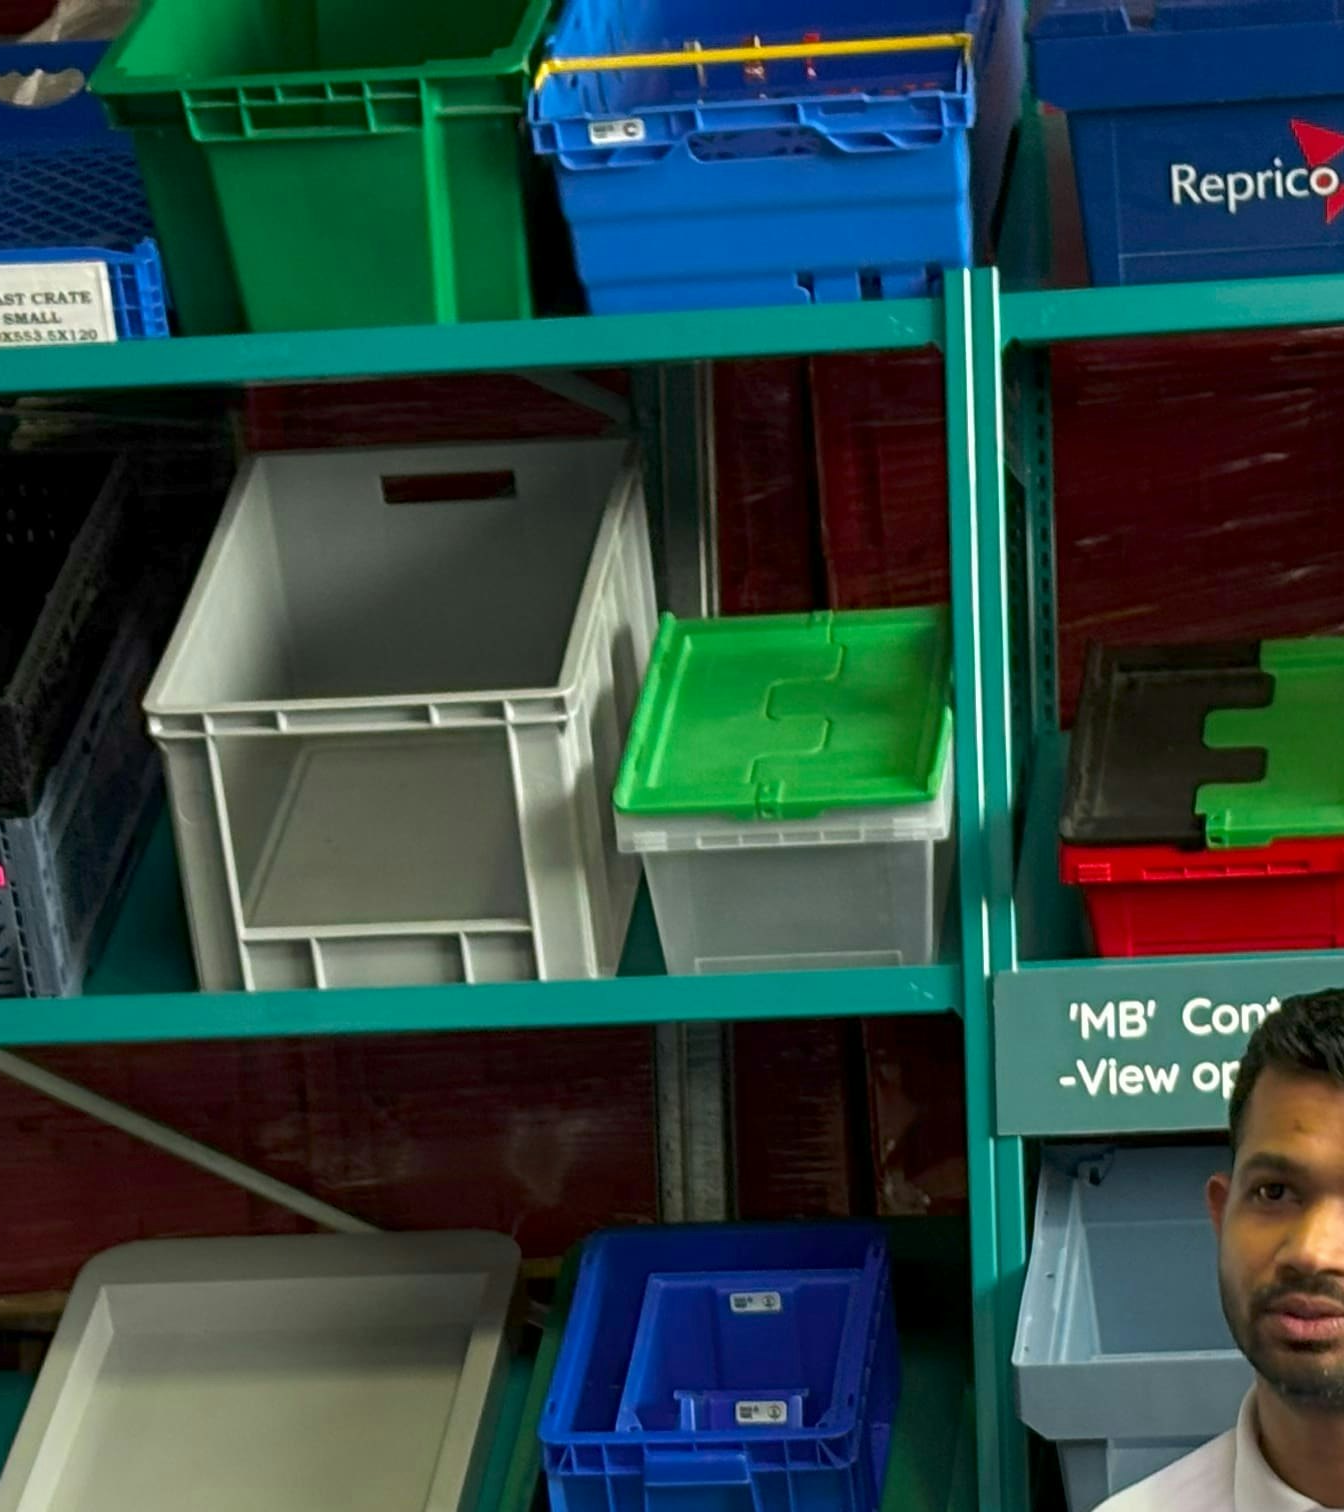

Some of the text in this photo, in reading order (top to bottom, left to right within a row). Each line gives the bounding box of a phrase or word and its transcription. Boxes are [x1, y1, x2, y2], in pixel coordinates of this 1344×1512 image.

[1170, 156, 1340, 214] Reprico
[2, 310, 62, 325] SMALL
[31, 290, 93, 306] CRATE
[1069, 998, 1156, 1040] 'MB'
[1058, 1057, 1180, 1097] -View
